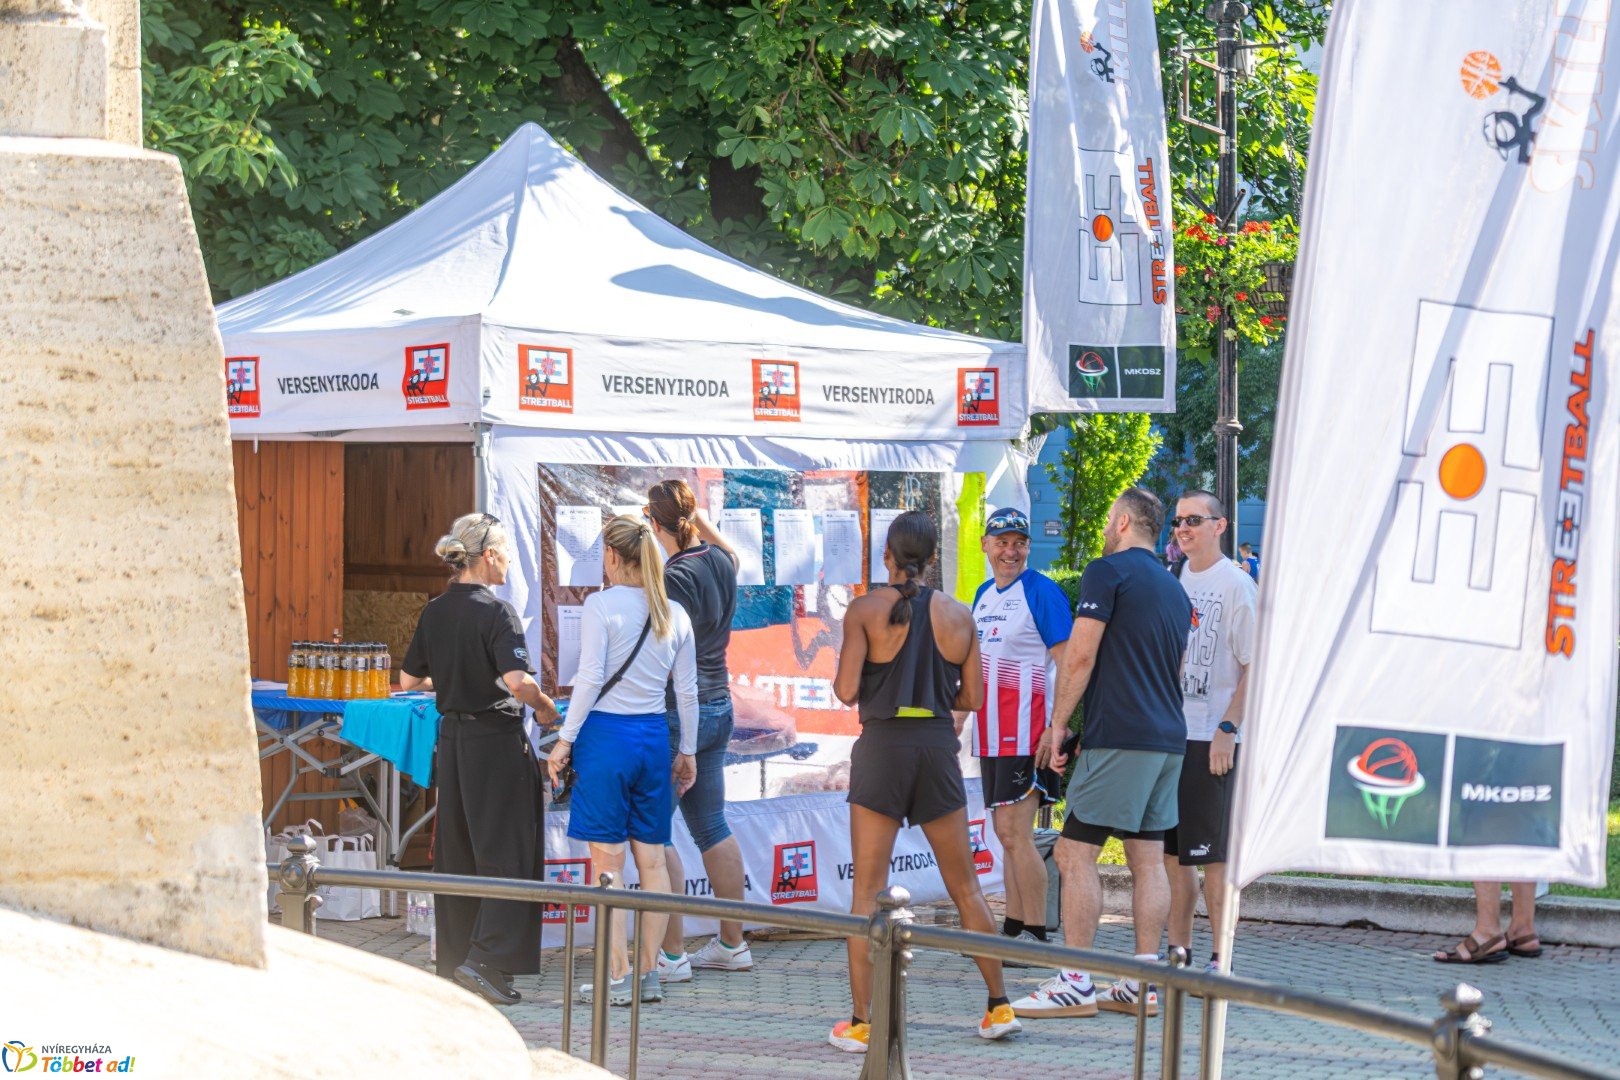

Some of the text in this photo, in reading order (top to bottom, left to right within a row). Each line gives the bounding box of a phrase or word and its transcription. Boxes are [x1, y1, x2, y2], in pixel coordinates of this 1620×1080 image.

[1124, 367, 1161, 376] MKOSZ
[277, 372, 380, 395] VERSENYIRODA
[601, 374, 730, 398] VERSENYIRODA
[822, 384, 935, 405] VERSENYIRODA
[1461, 783, 1552, 803] MKOSZ
[837, 852, 937, 881] VEYIRODA
